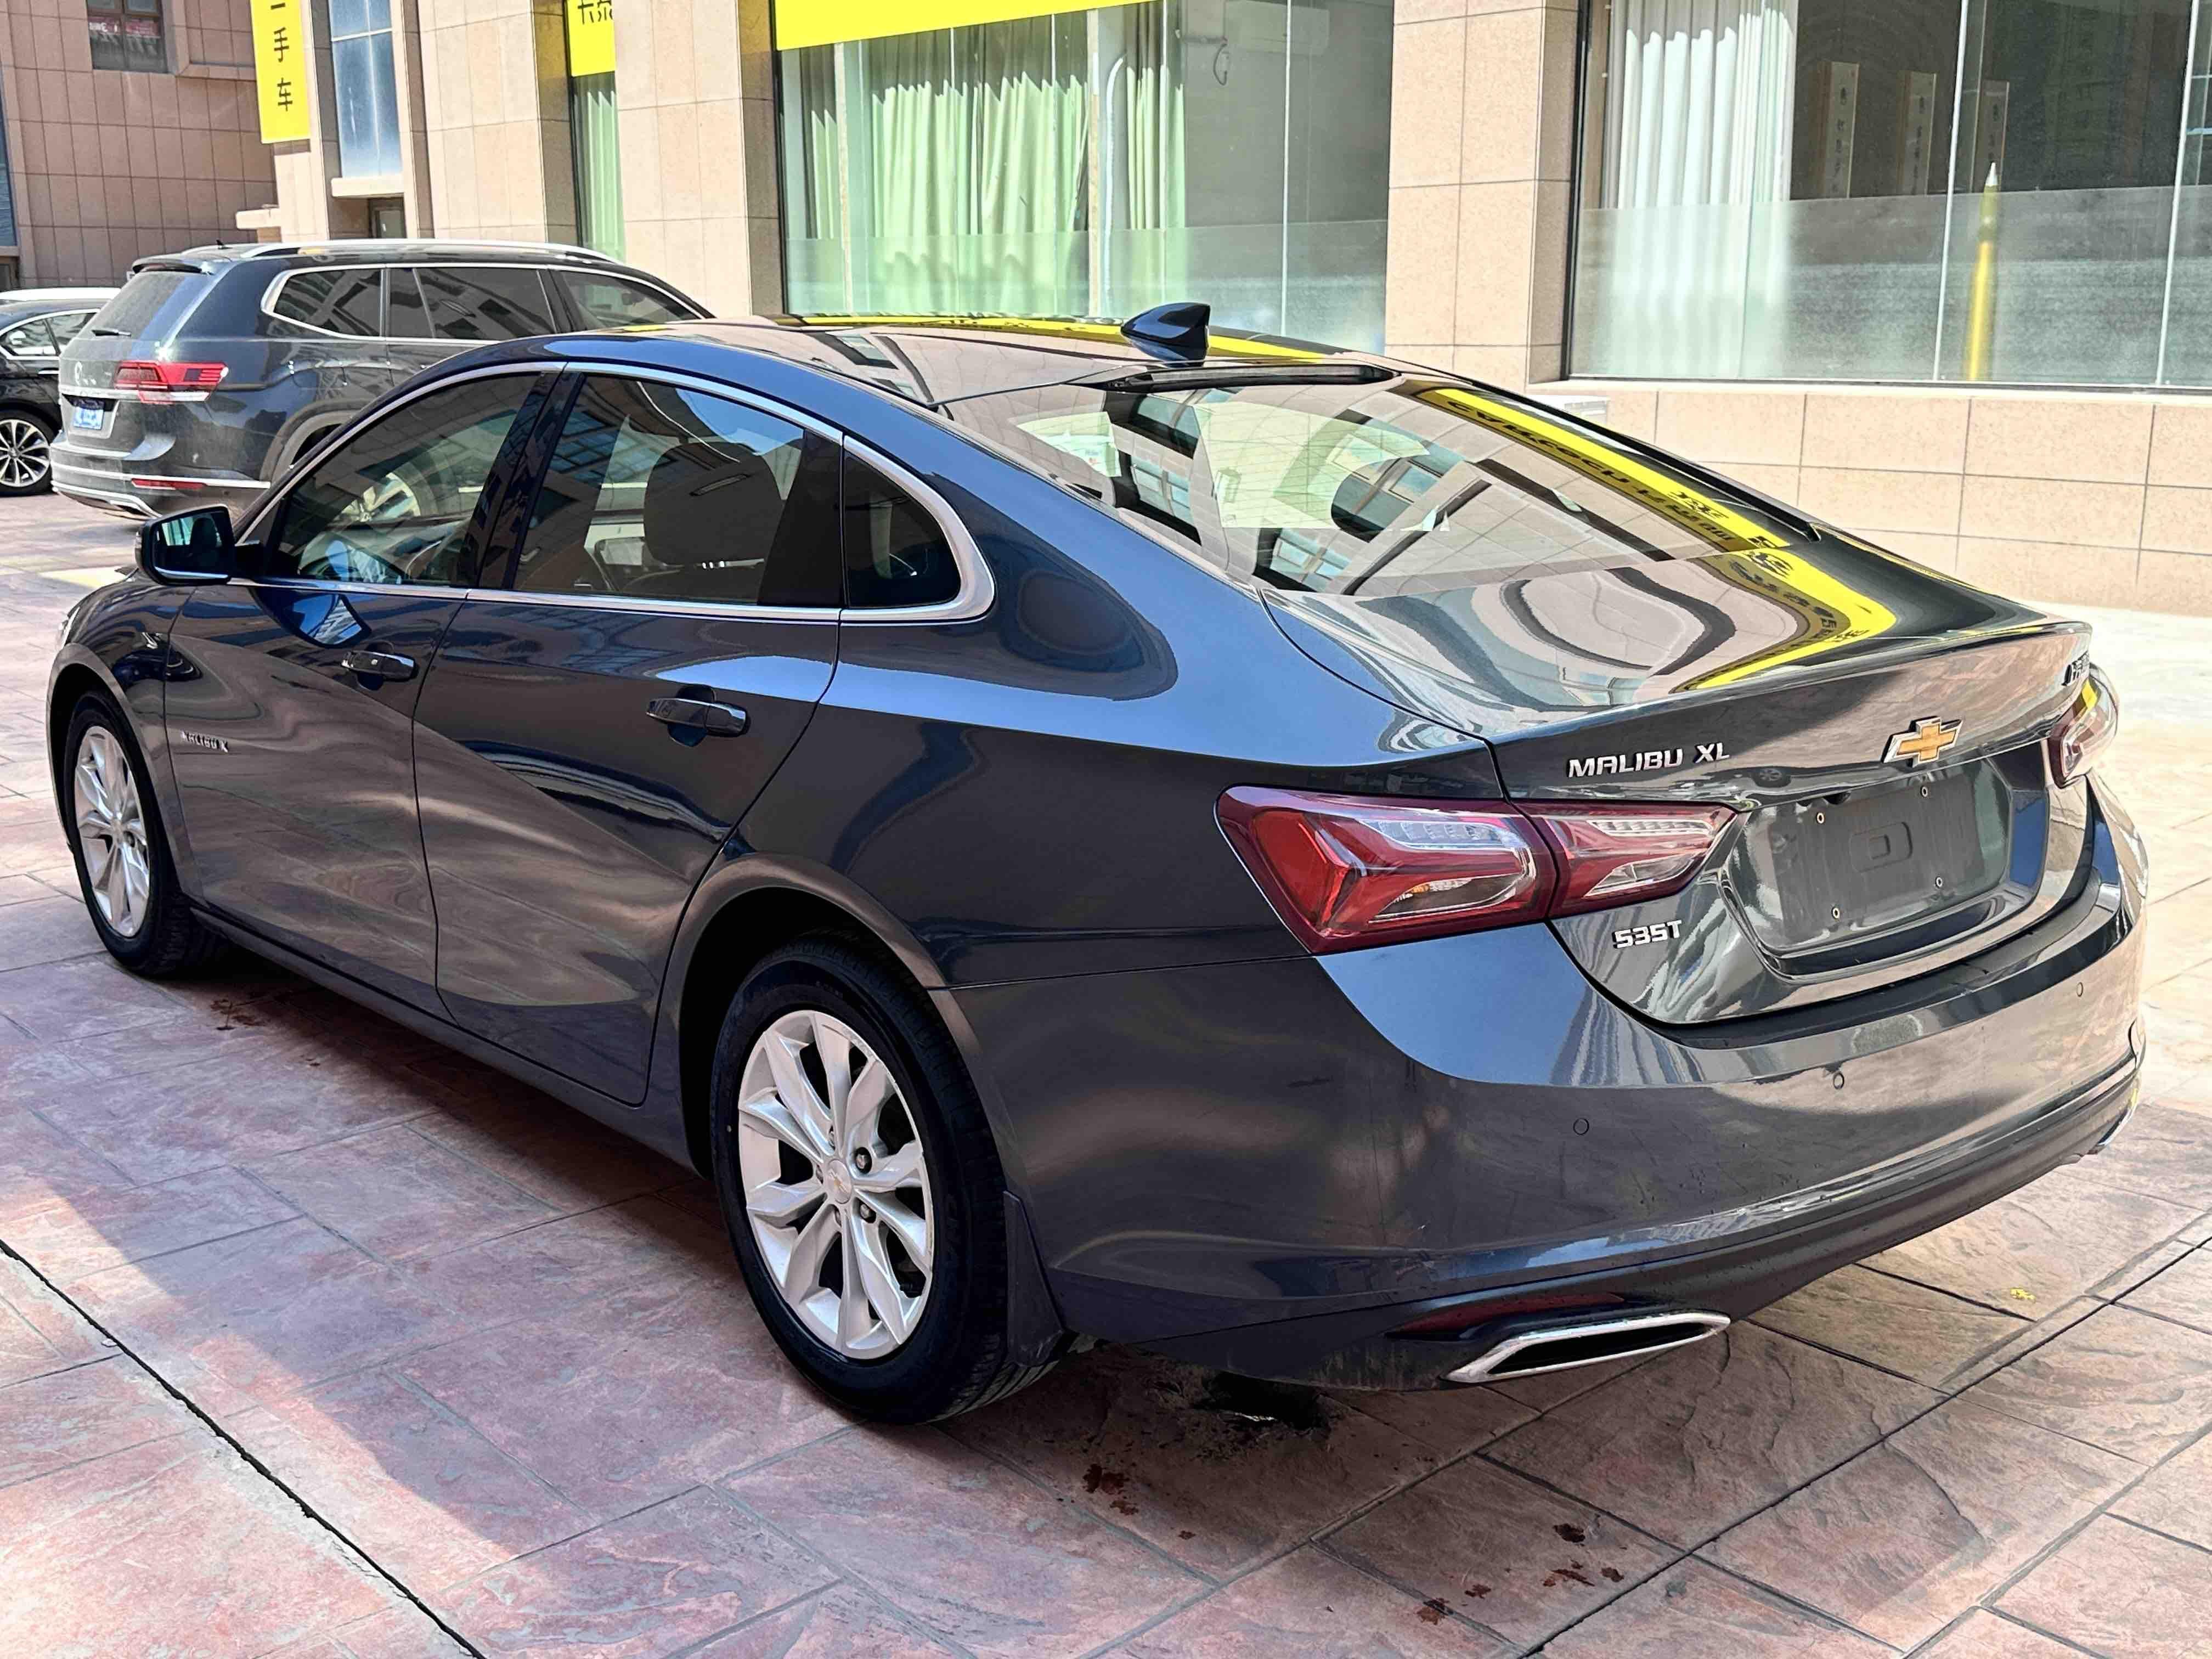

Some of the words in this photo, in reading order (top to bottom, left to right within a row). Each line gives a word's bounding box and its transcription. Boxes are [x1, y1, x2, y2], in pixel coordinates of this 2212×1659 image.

[1568, 748, 1683, 777] MALIBU
[1694, 742, 1730, 764] XL
[1614, 920, 1681, 949] 535T
